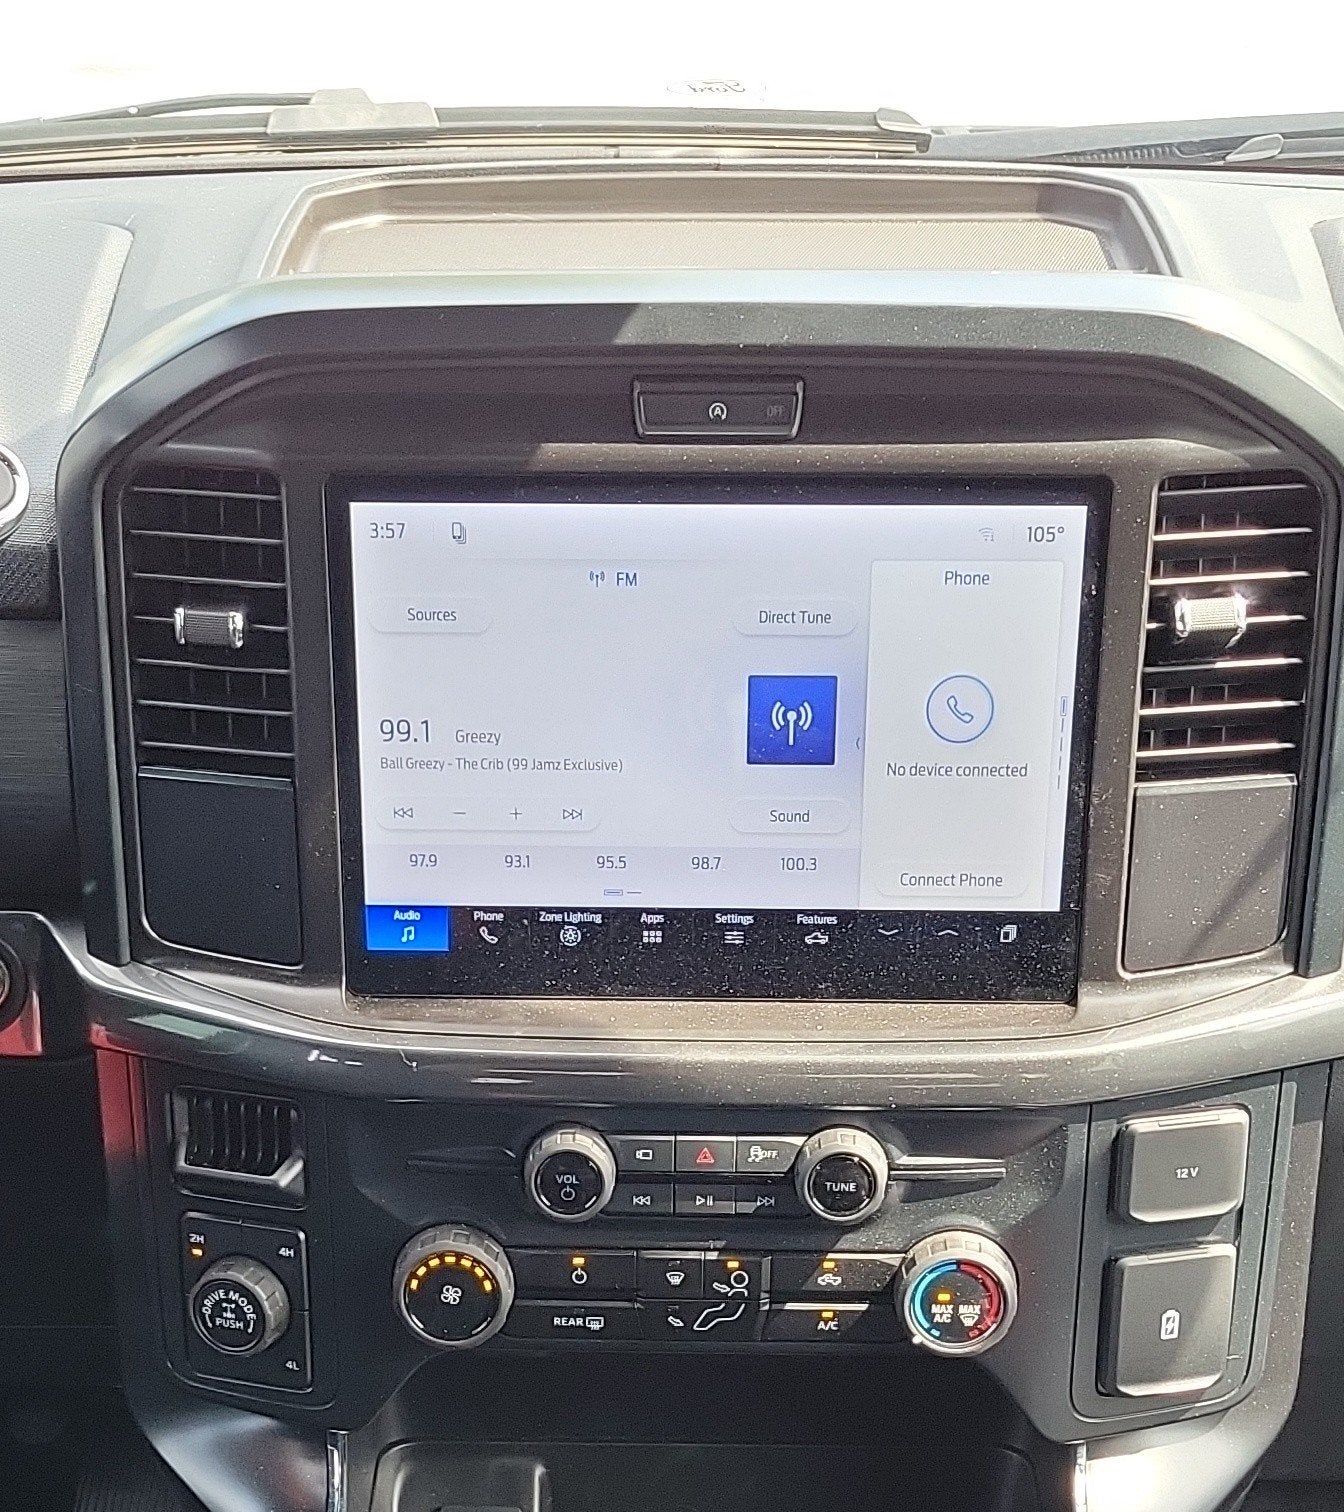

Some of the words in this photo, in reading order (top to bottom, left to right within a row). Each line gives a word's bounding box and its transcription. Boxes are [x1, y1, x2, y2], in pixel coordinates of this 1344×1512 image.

[369, 522, 406, 540] 3:57
[1026, 525, 1065, 543] 105°
[615, 572, 638, 587] FM
[944, 570, 991, 586] Phone
[407, 607, 457, 622] Sources
[759, 610, 796, 625] Direct
[799, 610, 832, 625] Tune
[379, 719, 431, 743] 99.1
[455, 729, 502, 746] Greezy
[380, 757, 403, 770] Ball
[406, 757, 445, 772] Greezy
[455, 757, 478, 770] The
[480, 757, 504, 771] Crib
[507, 758, 528, 772] (99
[531, 758, 561, 771] Jamz
[563, 758, 623, 772] Exclusive)
[886, 762, 905, 777] No
[908, 762, 953, 778] device
[956, 763, 1028, 778] connected
[769, 809, 810, 823] Sound
[409, 854, 438, 869] 97.9
[504, 854, 531, 869] 93.1
[596, 855, 627, 870] 95.5
[691, 856, 722, 871] 98.7
[780, 857, 817, 872] 100.3
[900, 872, 956, 888] Connect
[959, 872, 1003, 888] Phone
[394, 909, 421, 921] Audio
[473, 910, 504, 921] Phone
[539, 911, 563, 922] Zone
[565, 911, 602, 924] Lighting
[640, 913, 665, 926] Apps
[715, 913, 754, 925] Settings
[797, 914, 838, 925] Features
[760, 1150, 778, 1159] OFF
[556, 1174, 579, 1185] VOL
[824, 1181, 857, 1193] TUNE
[188, 1233, 205, 1245] 2H
[278, 1247, 295, 1258] 4H
[202, 1289, 227, 1314] DRIVE
[228, 1290, 257, 1321] MODE
[931, 1304, 954, 1315] MAX
[958, 1304, 981, 1315] MAX
[215, 1317, 244, 1330] PUSH
[554, 1317, 583, 1327] REAR
[933, 1313, 951, 1324] A/C
[817, 1320, 839, 1331] A/C
[285, 1360, 300, 1371] 4L
